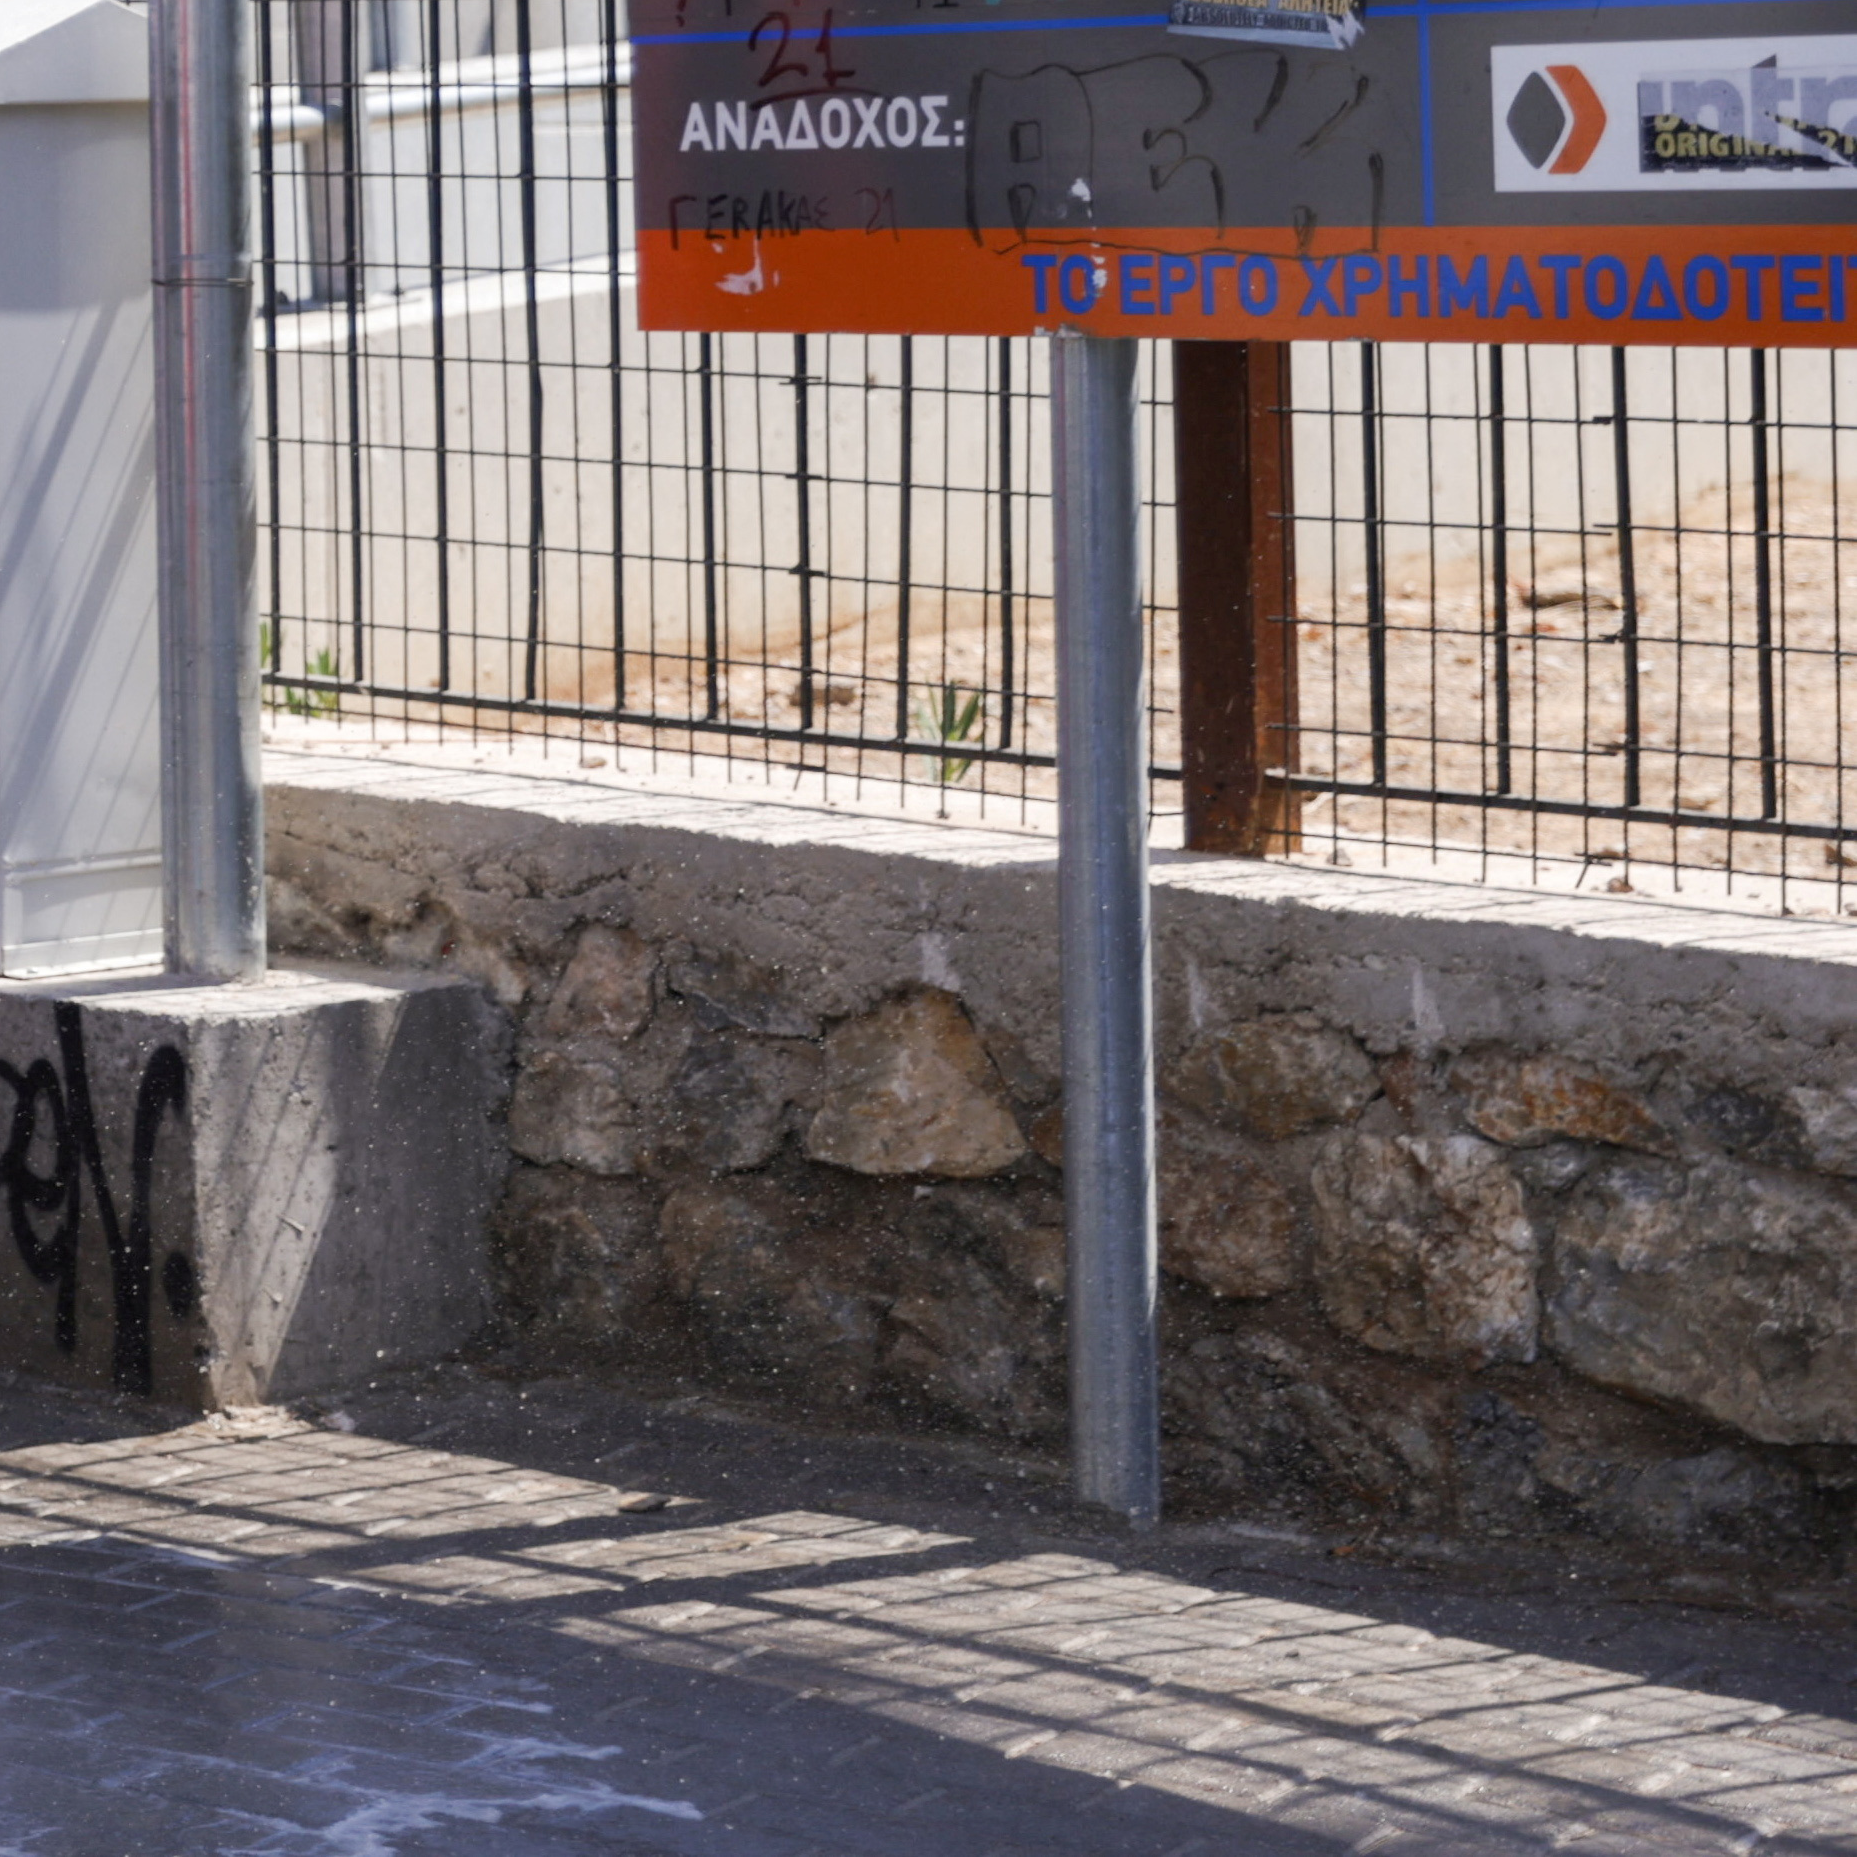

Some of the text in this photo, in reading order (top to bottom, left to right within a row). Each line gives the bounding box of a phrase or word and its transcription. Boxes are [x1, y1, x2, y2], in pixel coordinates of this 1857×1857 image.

[747, 10, 856, 88] 21
[681, 96, 966, 152] ΑΝΑΔΟΧΟΣ:
[1021, 254, 1857, 323] ΤΟ ΕΡΓΟ ΧΡΗΜΑΤΟΔΟΤΕΙ
